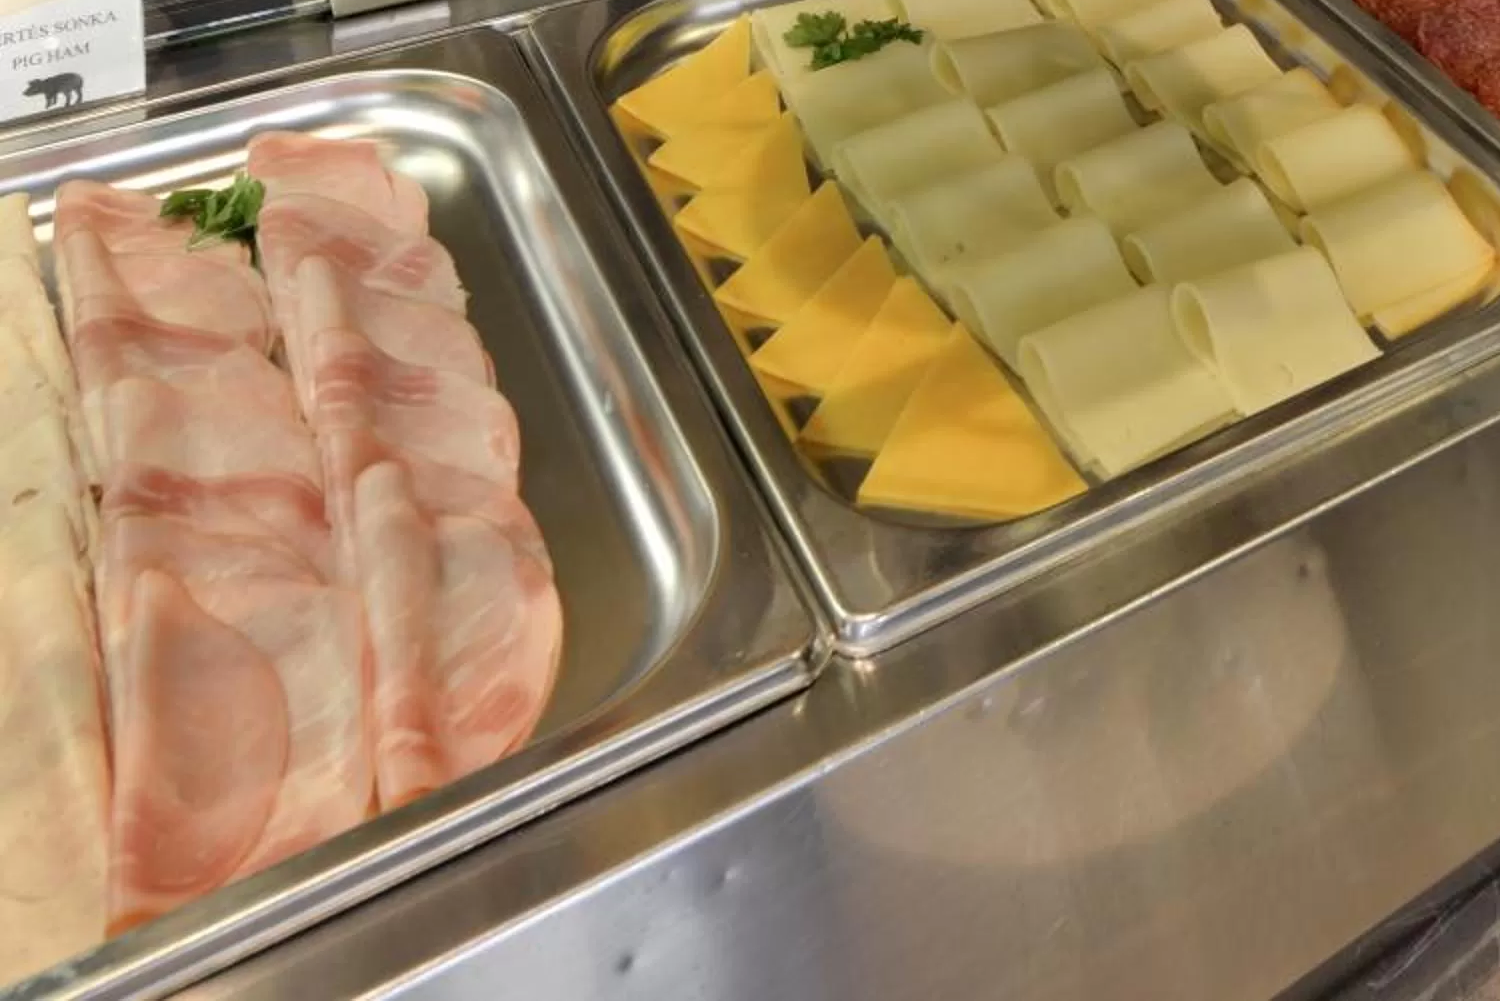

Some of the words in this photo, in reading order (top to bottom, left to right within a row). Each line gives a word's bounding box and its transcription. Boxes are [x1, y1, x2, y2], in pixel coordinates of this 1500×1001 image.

[0, 23, 49, 47] RTÉS
[53, 10, 119, 33] SONKA
[12, 51, 43, 71] PIG
[47, 41, 91, 64] HAM
